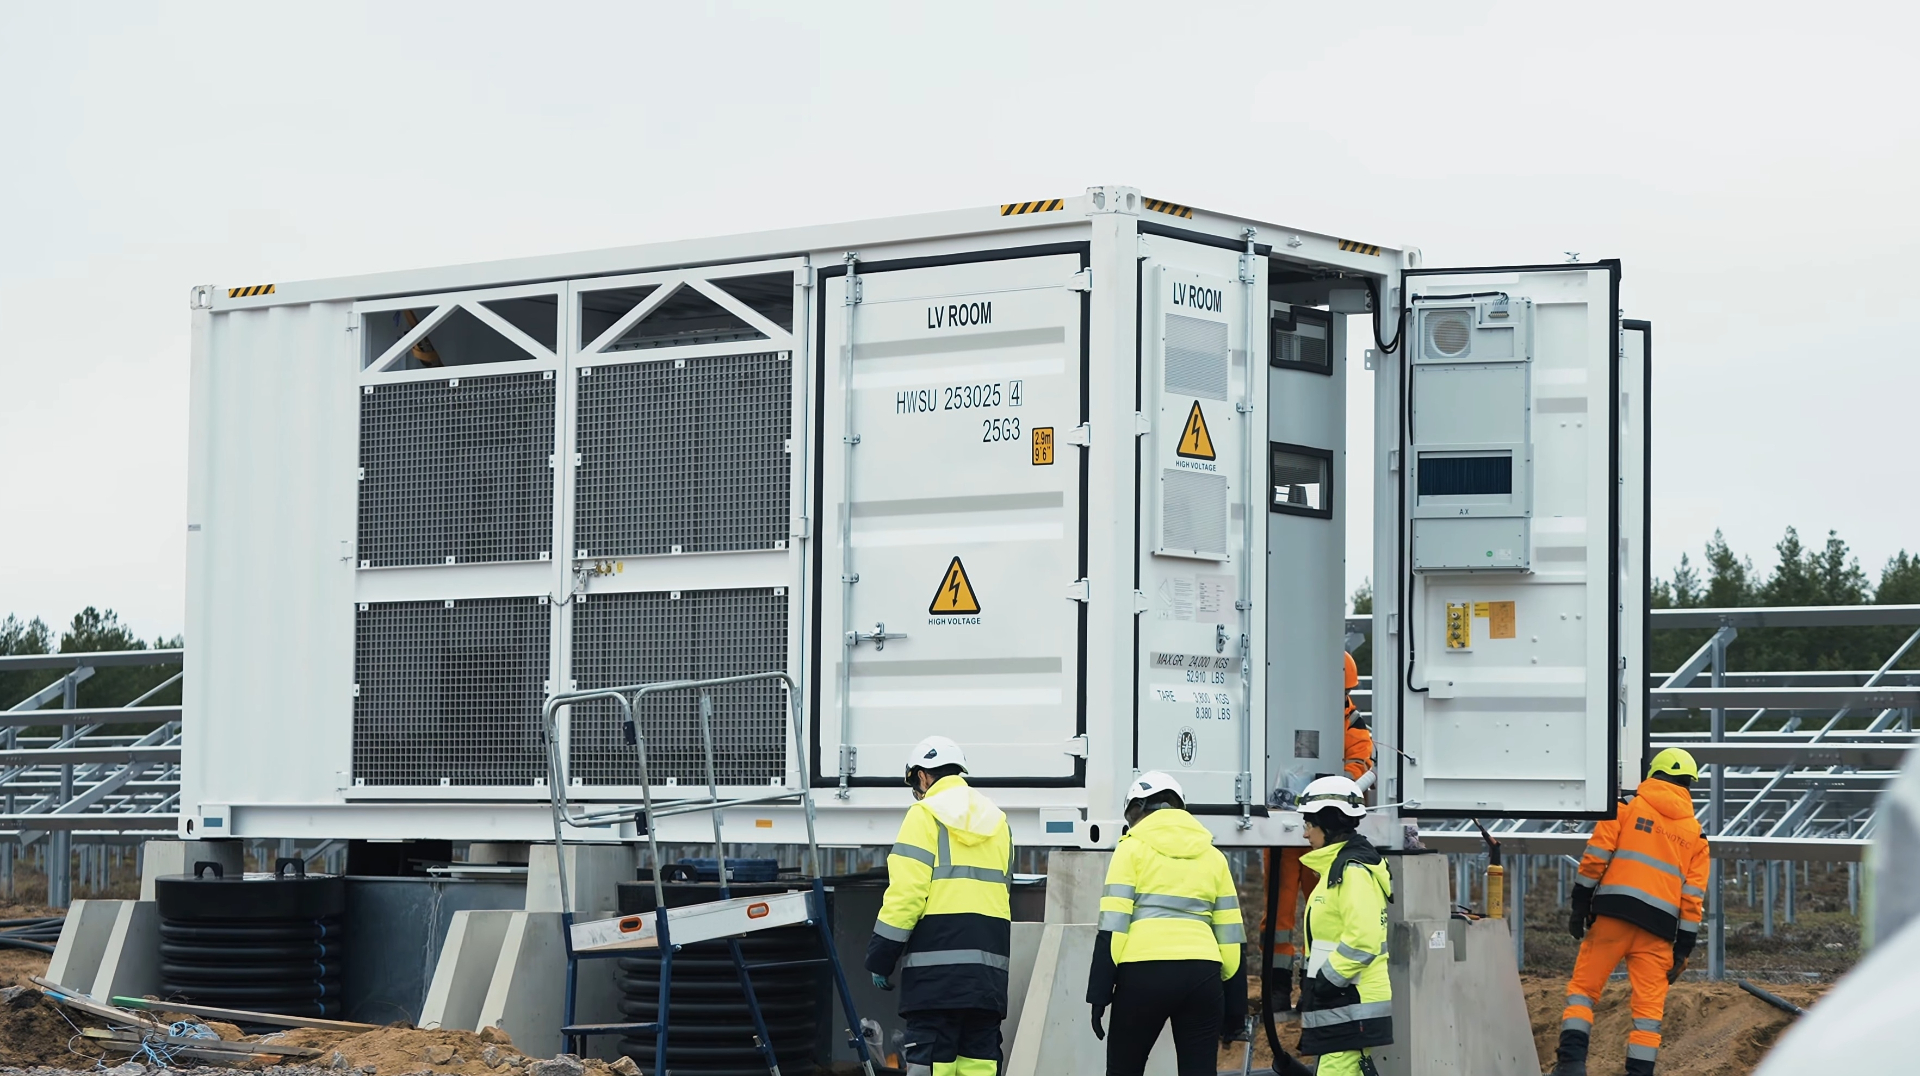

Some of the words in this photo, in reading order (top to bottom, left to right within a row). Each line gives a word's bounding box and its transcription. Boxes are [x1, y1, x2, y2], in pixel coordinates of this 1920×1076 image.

[1173, 282, 1186, 305] LV
[1189, 285, 1221, 313] ROOM
[928, 306, 944, 329] LV
[949, 302, 991, 326] ROOM
[896, 389, 937, 414] HWSU
[944, 383, 1001, 410] 253025
[1011, 382, 1020, 405] 4
[982, 417, 1020, 443] 25G3
[1035, 431, 1051, 445] 2.9m
[1176, 460, 1190, 468] HIGH
[1191, 462, 1216, 472] VOLTAGE
[948, 617, 981, 625] VOLTAGE
[1188, 655, 1211, 668] 24,000
[1213, 657, 1230, 669] KGS
[1186, 670, 1206, 683] 52,910
[1211, 671, 1225, 684] LBS
[1157, 690, 1176, 702] TARE
[1214, 693, 1230, 705] KGS
[1195, 707, 1212, 720] 8,380
[1217, 708, 1231, 720] LBS
[1656, 826, 1692, 850] SUNOTEC
